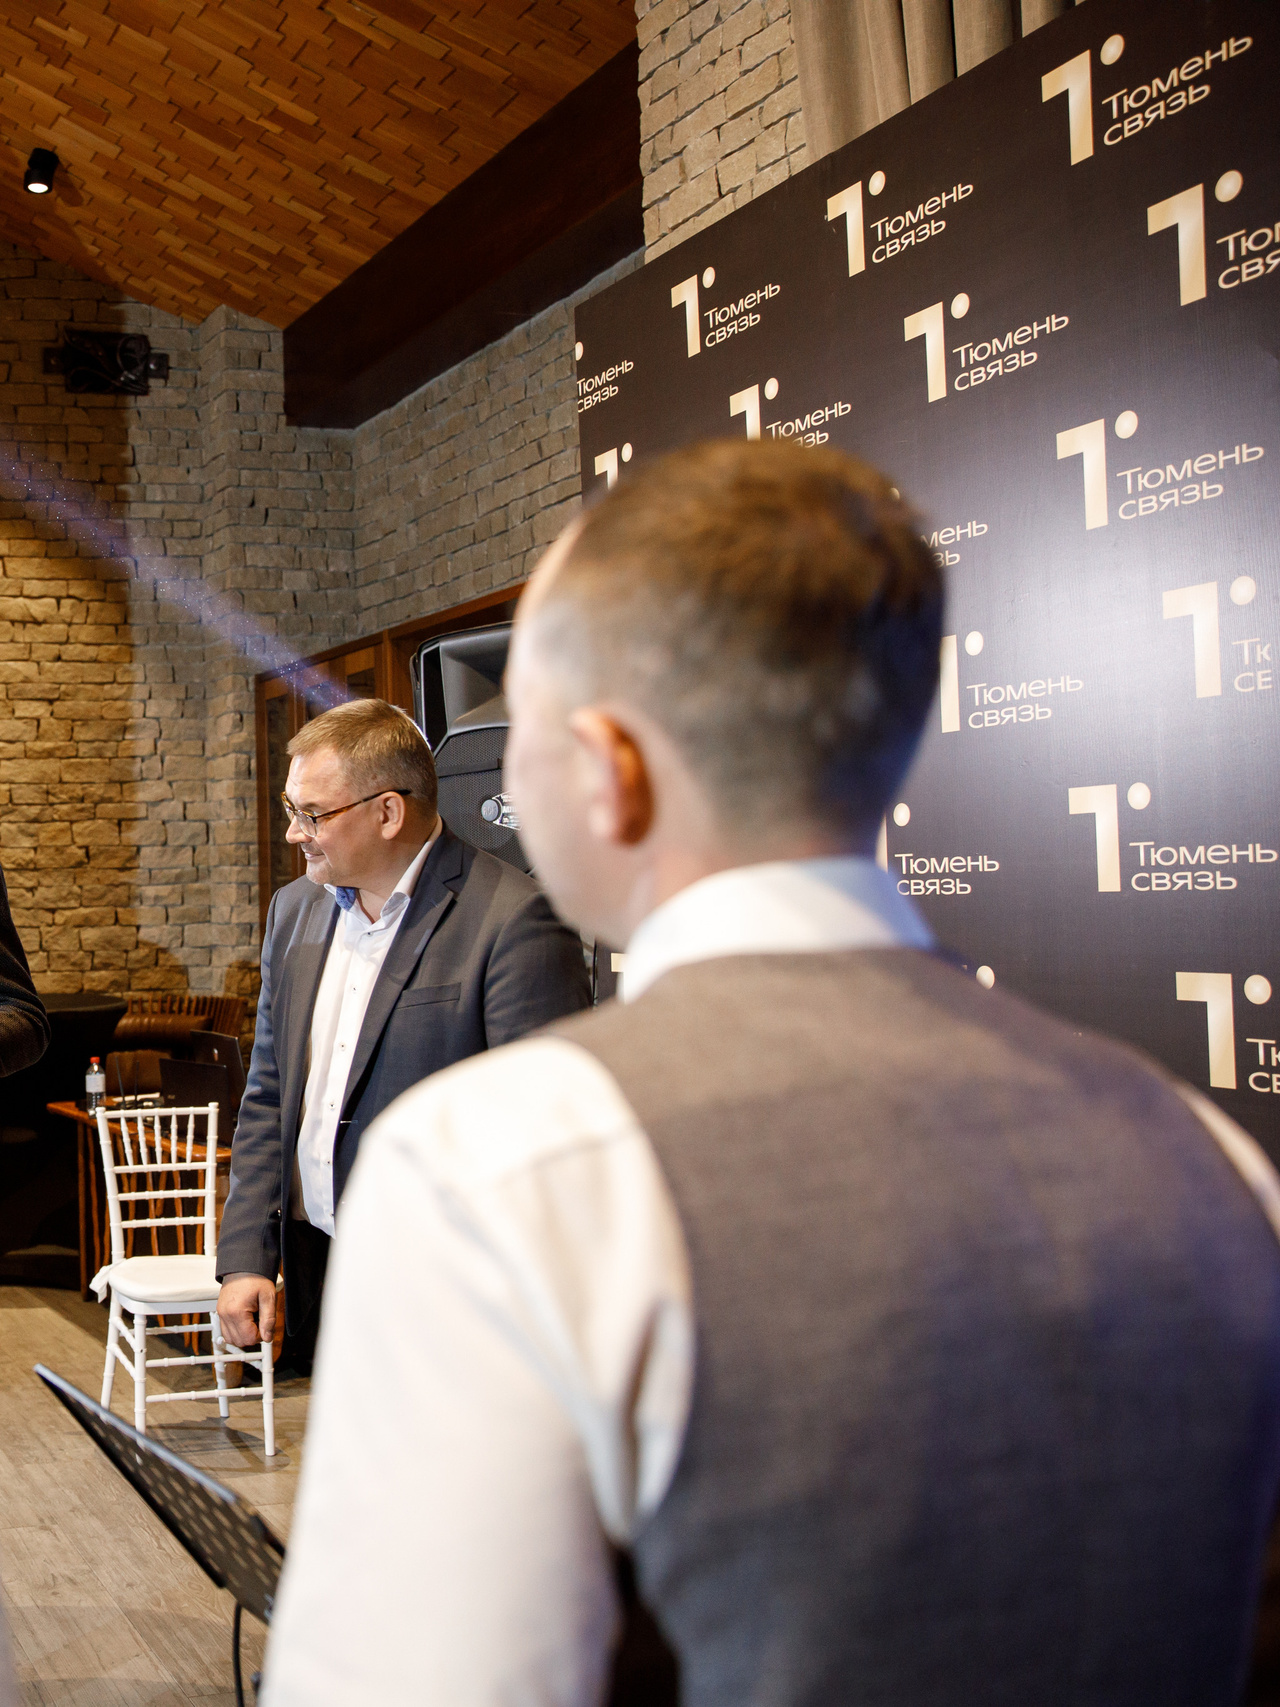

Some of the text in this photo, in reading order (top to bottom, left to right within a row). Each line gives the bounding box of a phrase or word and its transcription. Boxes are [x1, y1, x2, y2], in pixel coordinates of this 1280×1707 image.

[1102, 37, 1252, 119] Тюмень
[1103, 84, 1211, 146] связь
[870, 183, 974, 241] Тюмень
[871, 219, 946, 264] связь
[1218, 248, 1280, 289] свя
[704, 283, 780, 329] Тюмень
[705, 312, 761, 348] связь
[952, 314, 1069, 369] Тюмень
[577, 360, 634, 396] Тюмень
[954, 349, 1038, 391] связь
[1117, 443, 1265, 494] Тюмень
[1118, 481, 1223, 520] связь
[921, 520, 989, 549] мень
[966, 675, 1084, 706] Тюмень
[968, 703, 1052, 729] связь
[894, 853, 1000, 874] Тюмень
[1129, 841, 1279, 866] Тюмень
[896, 878, 972, 896] связь
[1130, 871, 1237, 891] связь
